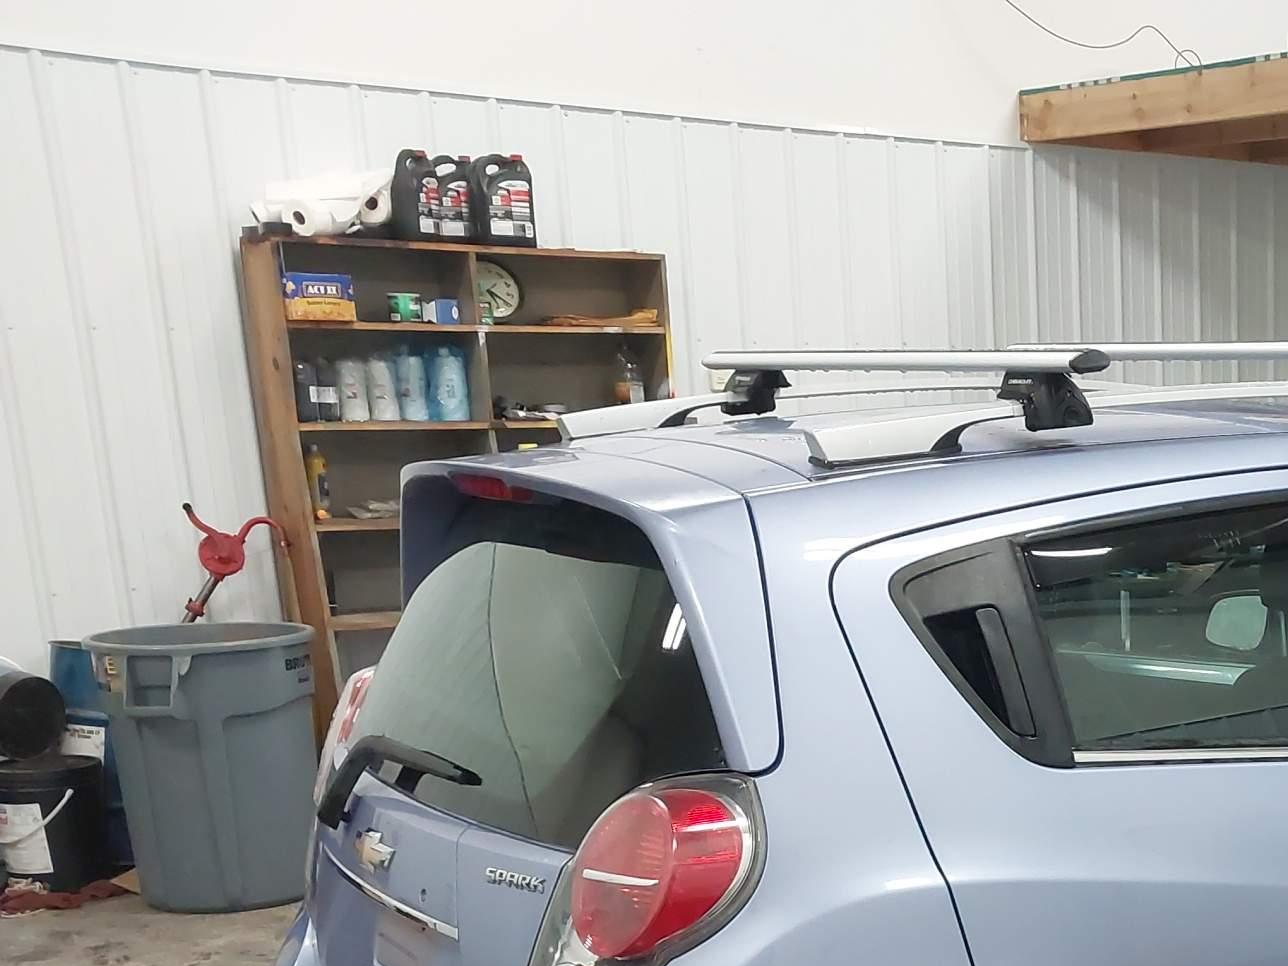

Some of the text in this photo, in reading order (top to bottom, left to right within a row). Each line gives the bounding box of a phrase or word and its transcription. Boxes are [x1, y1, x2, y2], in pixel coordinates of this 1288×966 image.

[307, 285, 337, 294] ACT II
[486, 867, 546, 894] SPARK
